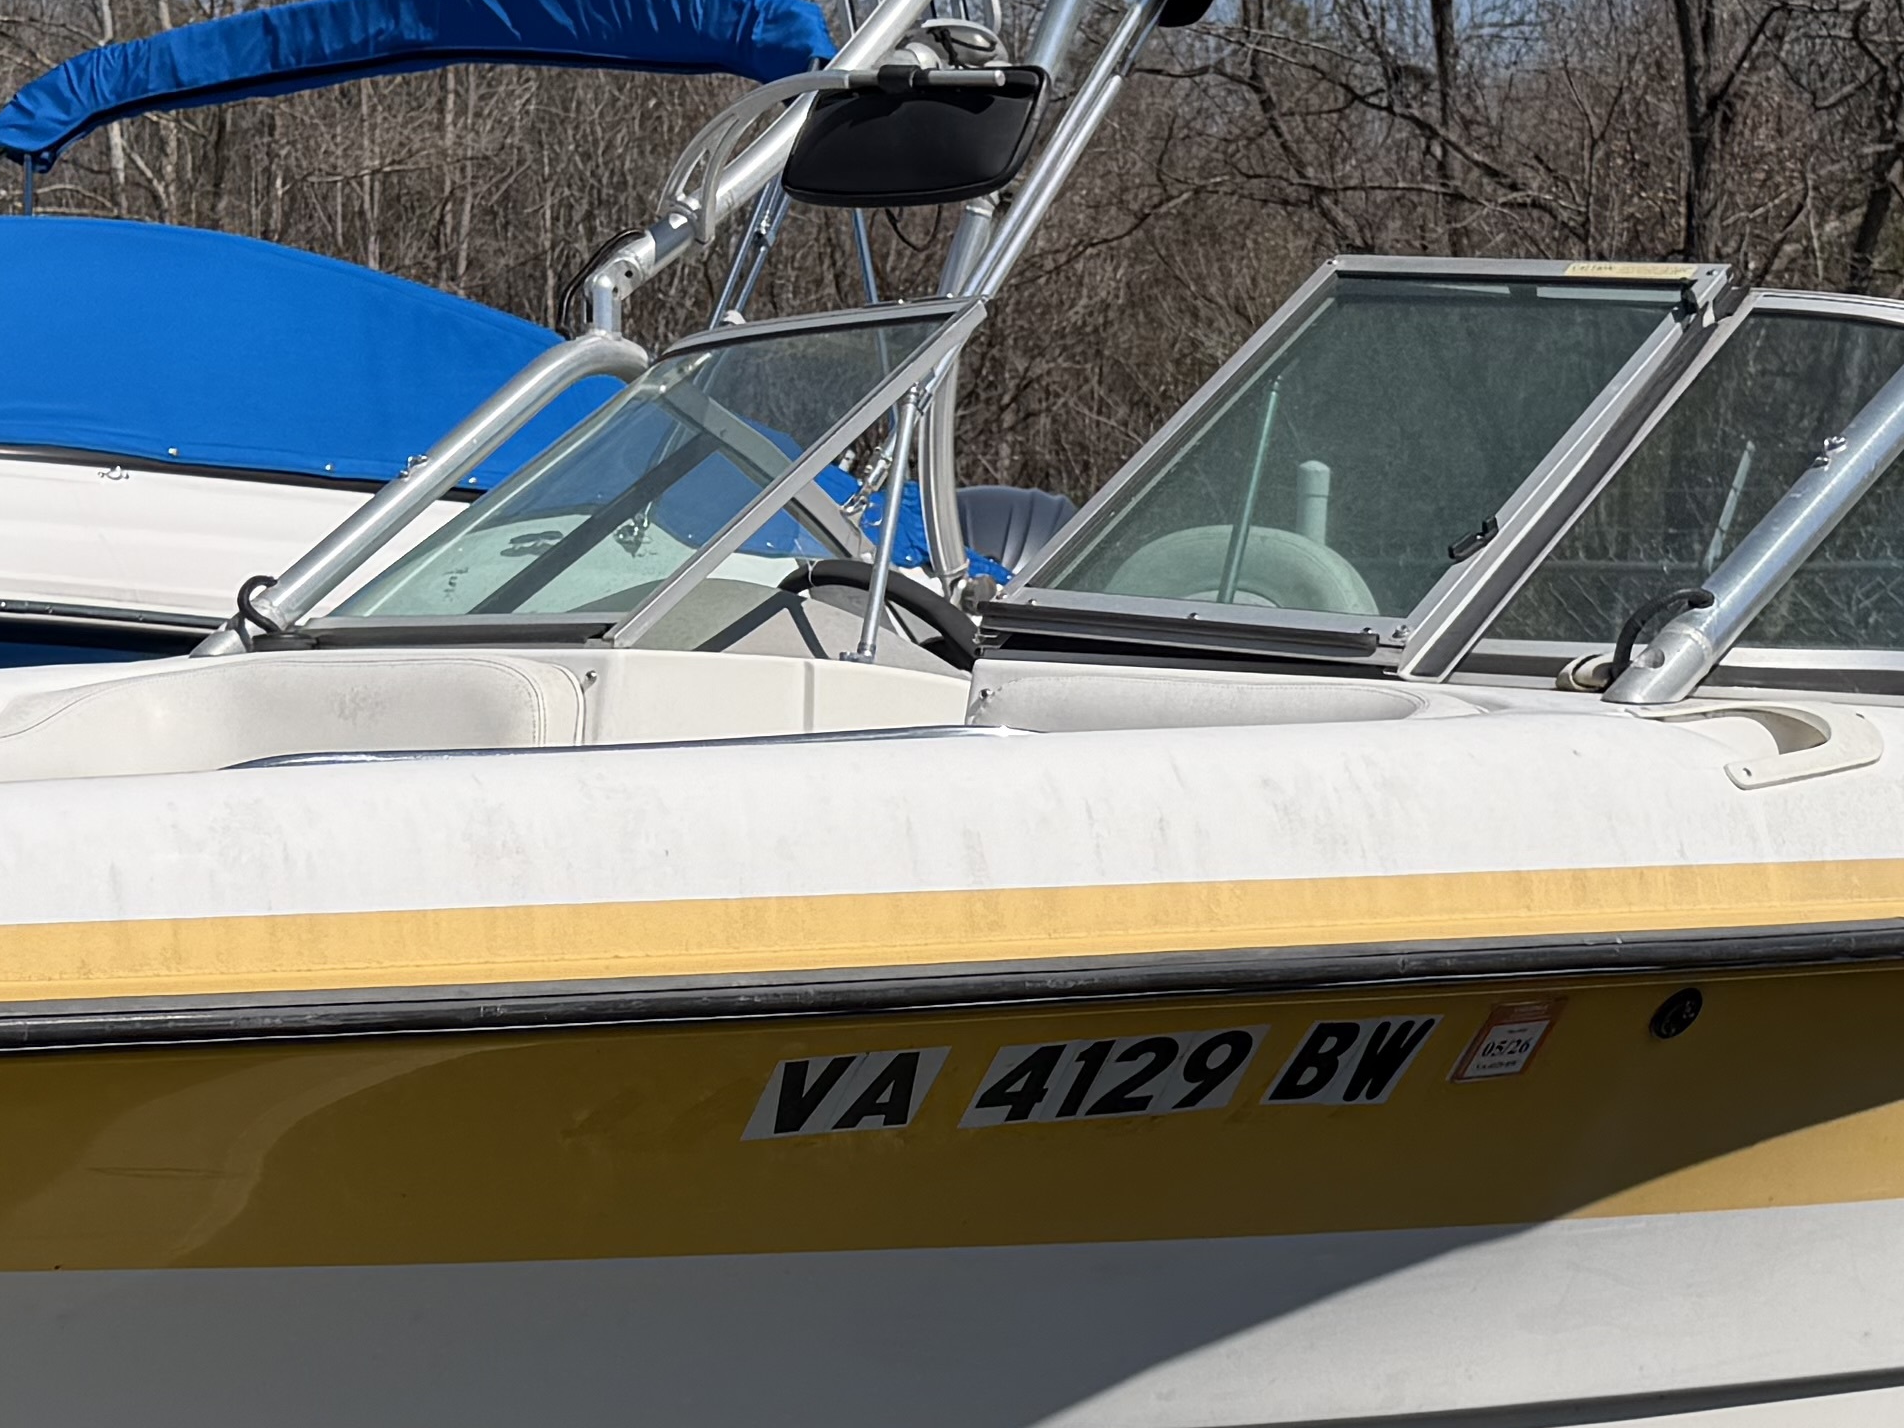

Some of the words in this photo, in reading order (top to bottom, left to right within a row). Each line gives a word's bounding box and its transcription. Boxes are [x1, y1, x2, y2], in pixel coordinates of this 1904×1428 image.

[773, 1050, 922, 1134] VA
[975, 1029, 1255, 1123] 4129
[1269, 1018, 1436, 1104] BW
[1481, 1036, 1534, 1058] 05/26
